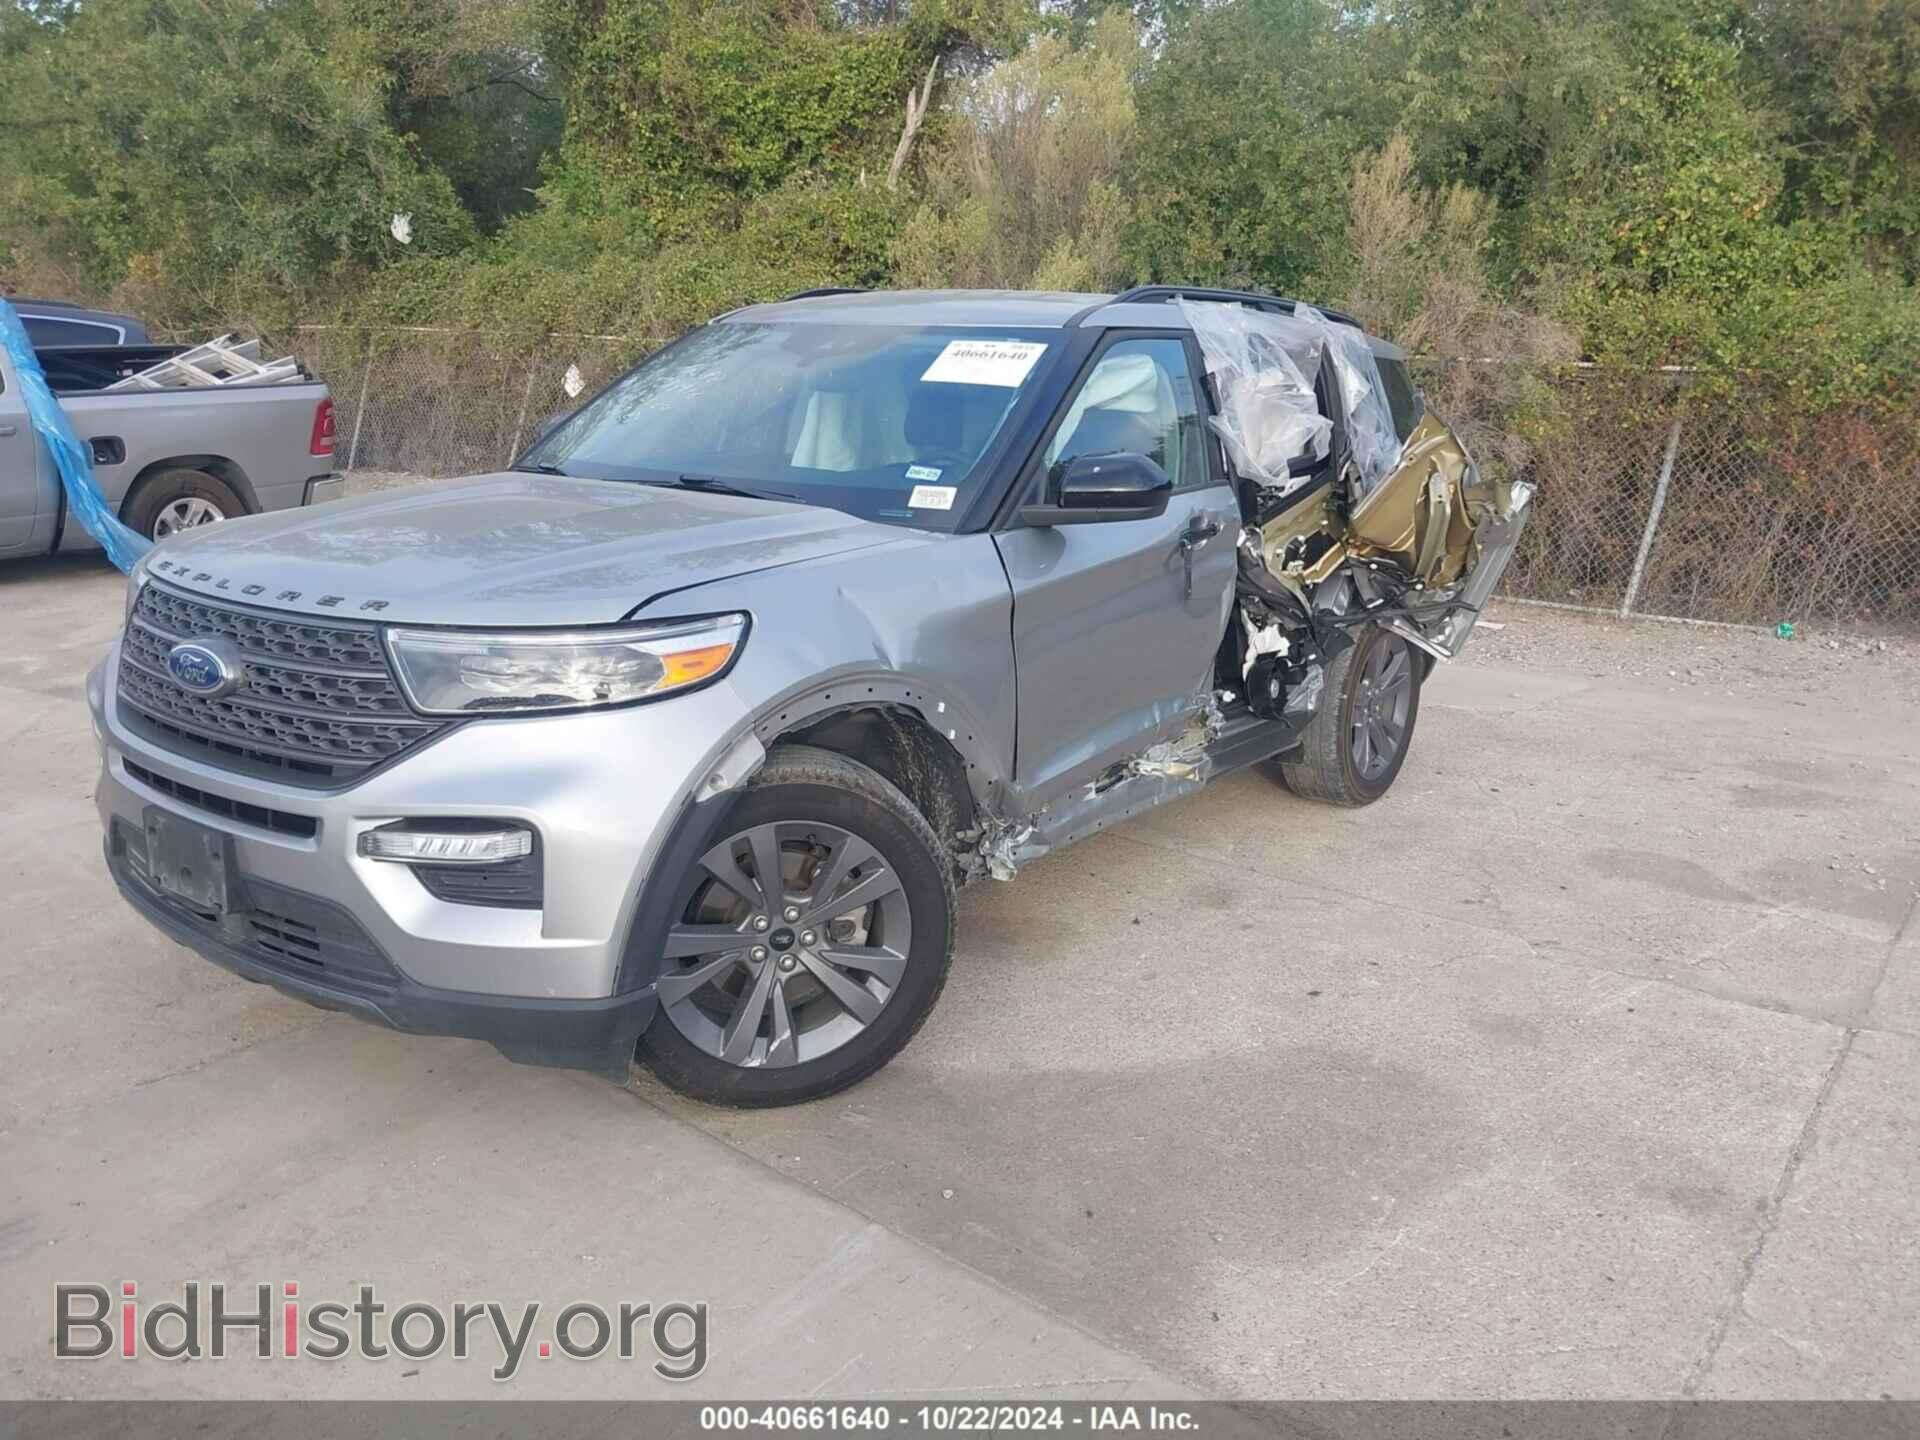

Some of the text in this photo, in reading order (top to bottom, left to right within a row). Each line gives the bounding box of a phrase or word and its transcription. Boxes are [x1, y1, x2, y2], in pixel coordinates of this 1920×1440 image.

[952, 349, 1029, 361] 40661640
[158, 560, 390, 612] EXPLORER
[176, 652, 209, 683] Ford
